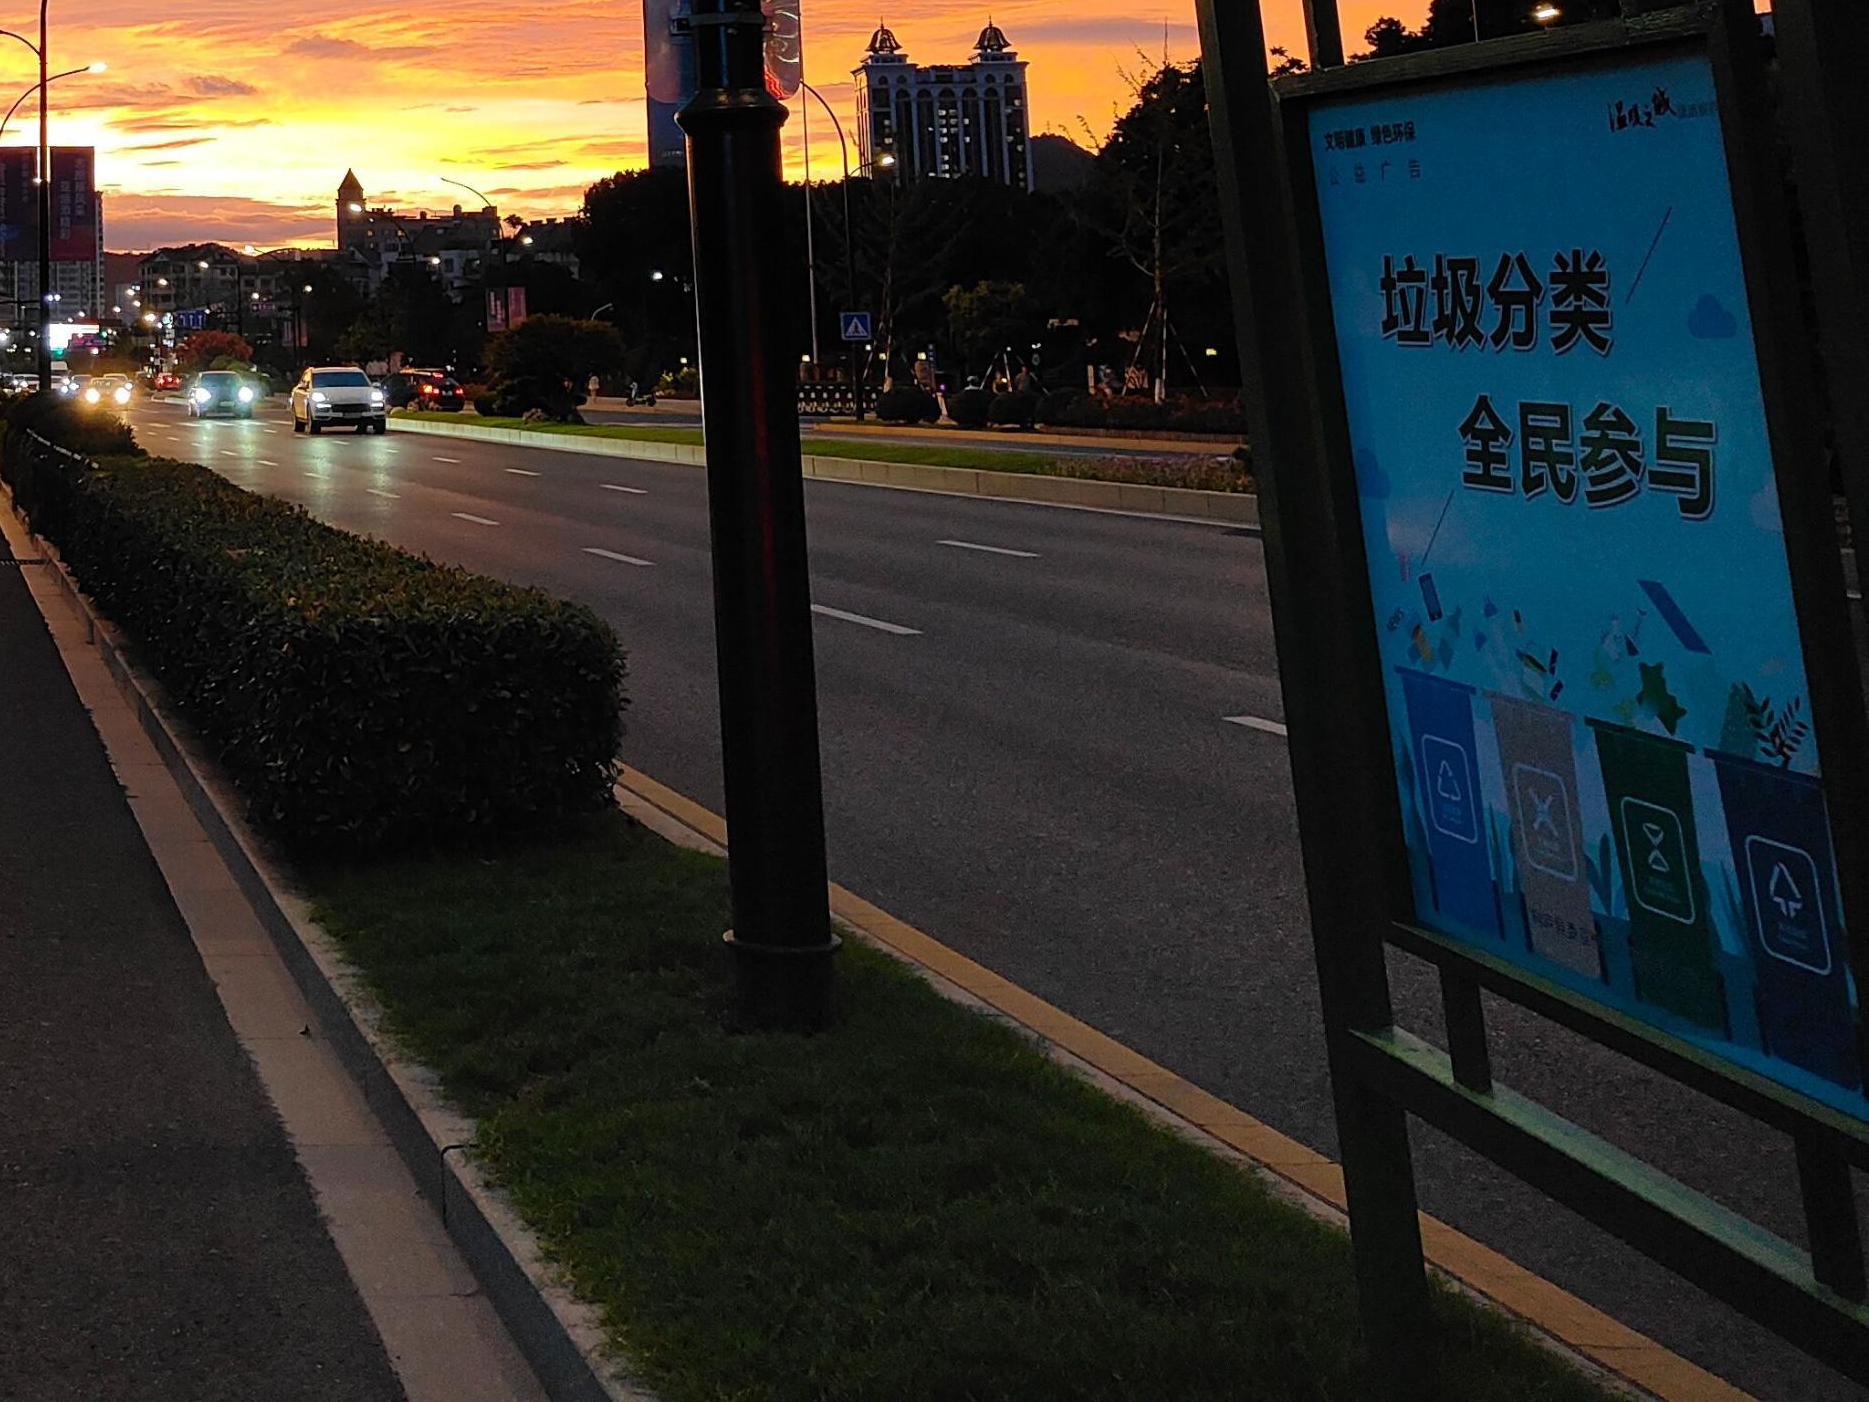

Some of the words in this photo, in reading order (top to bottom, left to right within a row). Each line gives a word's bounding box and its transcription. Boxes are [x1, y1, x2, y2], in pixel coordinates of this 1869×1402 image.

[1380, 248, 1611, 356] 垃圾分类
[1458, 393, 1716, 521] 全民参与
